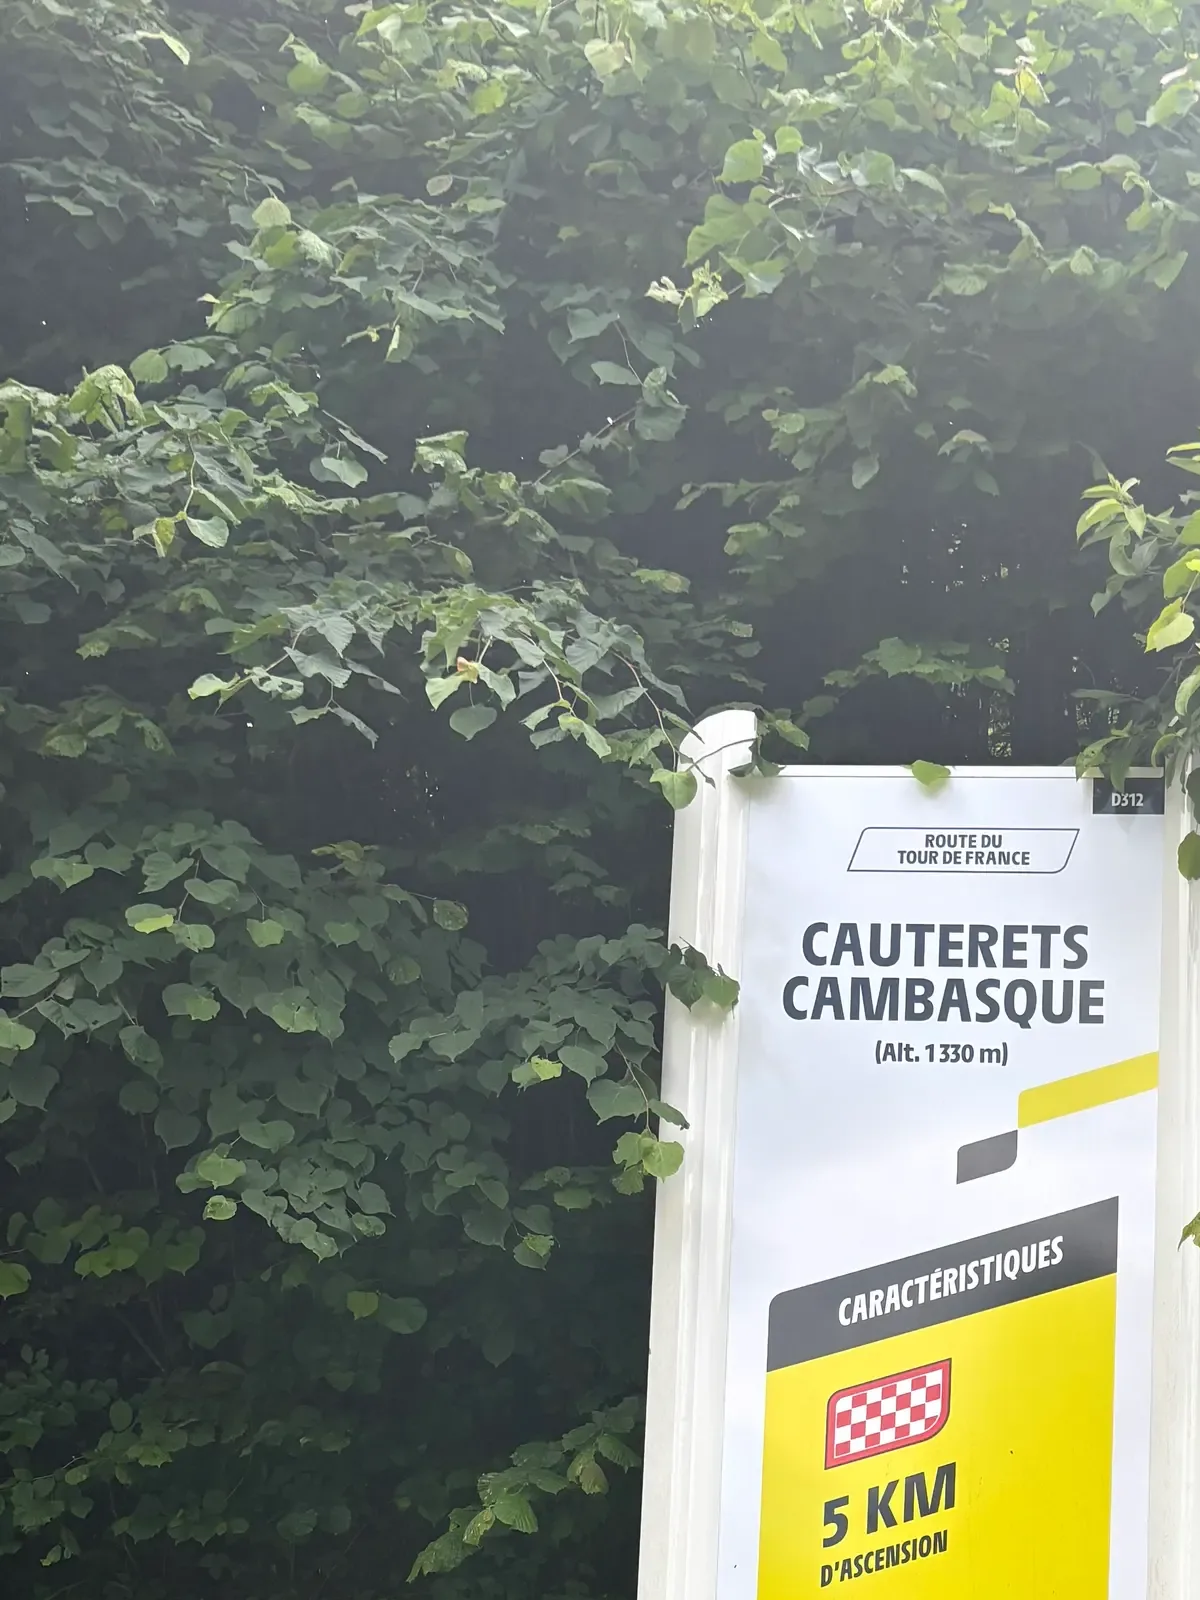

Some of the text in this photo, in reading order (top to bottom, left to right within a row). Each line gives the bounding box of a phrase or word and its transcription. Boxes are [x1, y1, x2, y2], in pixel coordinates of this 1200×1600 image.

[1111, 792, 1144, 807] D312
[898, 850, 1030, 866] TOUR DE FRANCE
[925, 834, 1002, 849] ROUTE DU
[802, 922, 1089, 969] CAUTERETS
[782, 975, 1105, 1029] CAMBASQUE
[875, 1040, 920, 1064] (Alt.
[979, 1042, 1008, 1066] m)
[838, 1235, 1063, 1326] CARACTÉRISTIQUES
[823, 1462, 957, 1548] 5 KM
[821, 1529, 948, 1588] D'ASCENSION
